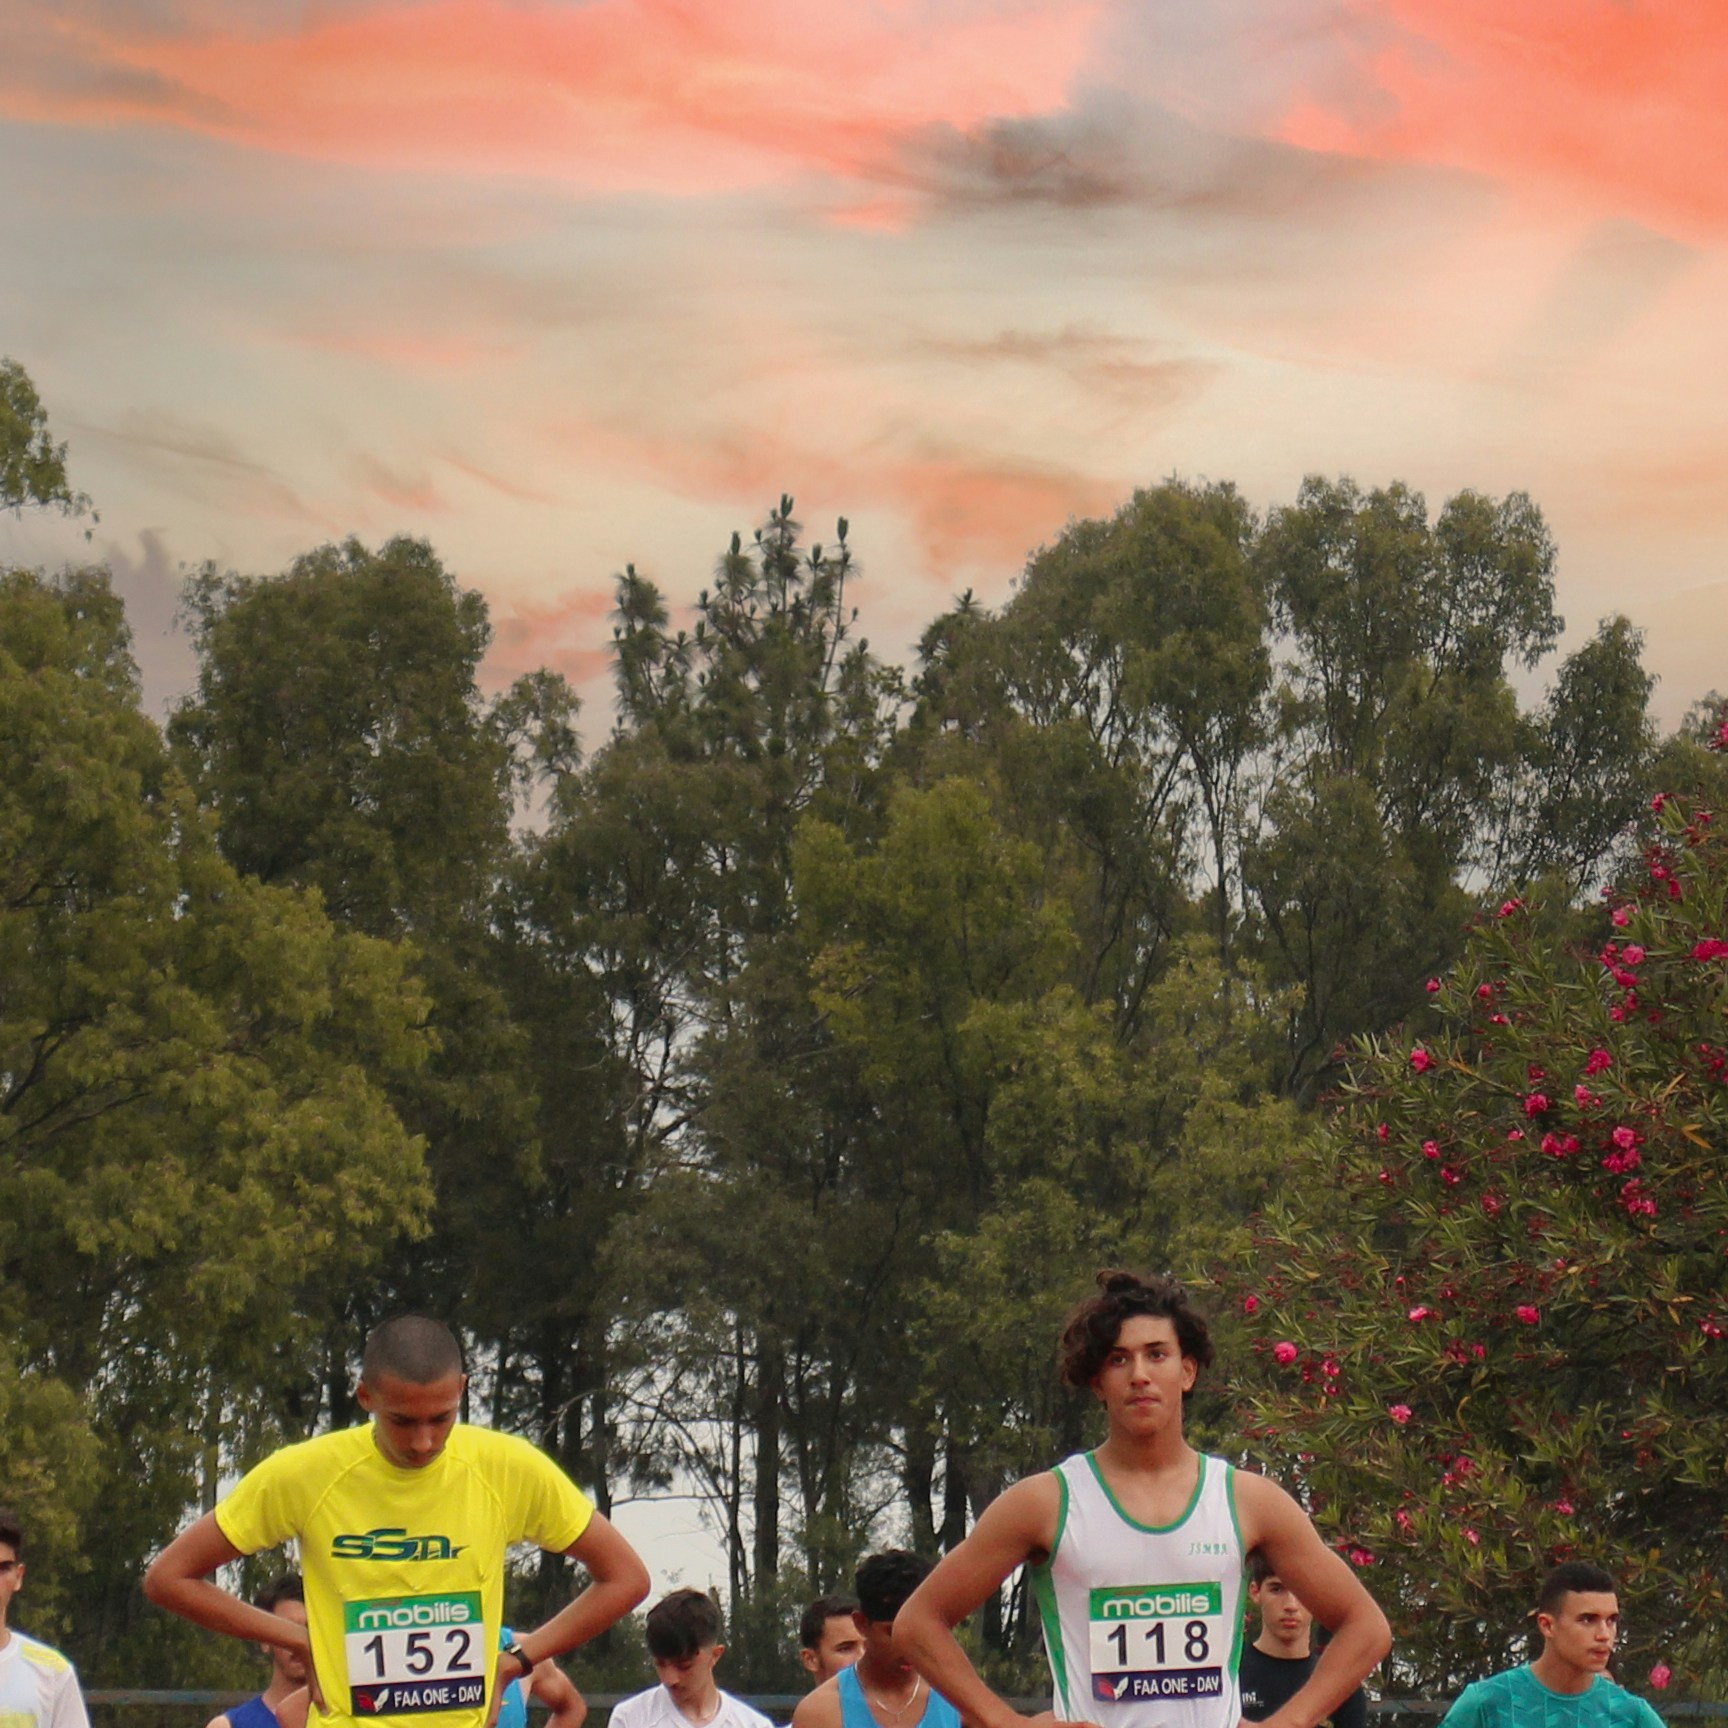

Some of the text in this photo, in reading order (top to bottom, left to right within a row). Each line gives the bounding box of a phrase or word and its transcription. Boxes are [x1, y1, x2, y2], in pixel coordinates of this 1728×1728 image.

[359, 1602, 470, 1628] mobilis
[1103, 1593, 1210, 1618] mobilis
[363, 1629, 472, 1678] 152
[1107, 1620, 1210, 1666] 118
[394, 1690, 421, 1708] FAA
[423, 1689, 449, 1706] ONE
[459, 1684, 482, 1703] DAY
[1133, 1679, 1158, 1696] FAA
[1161, 1678, 1189, 1695] ONE
